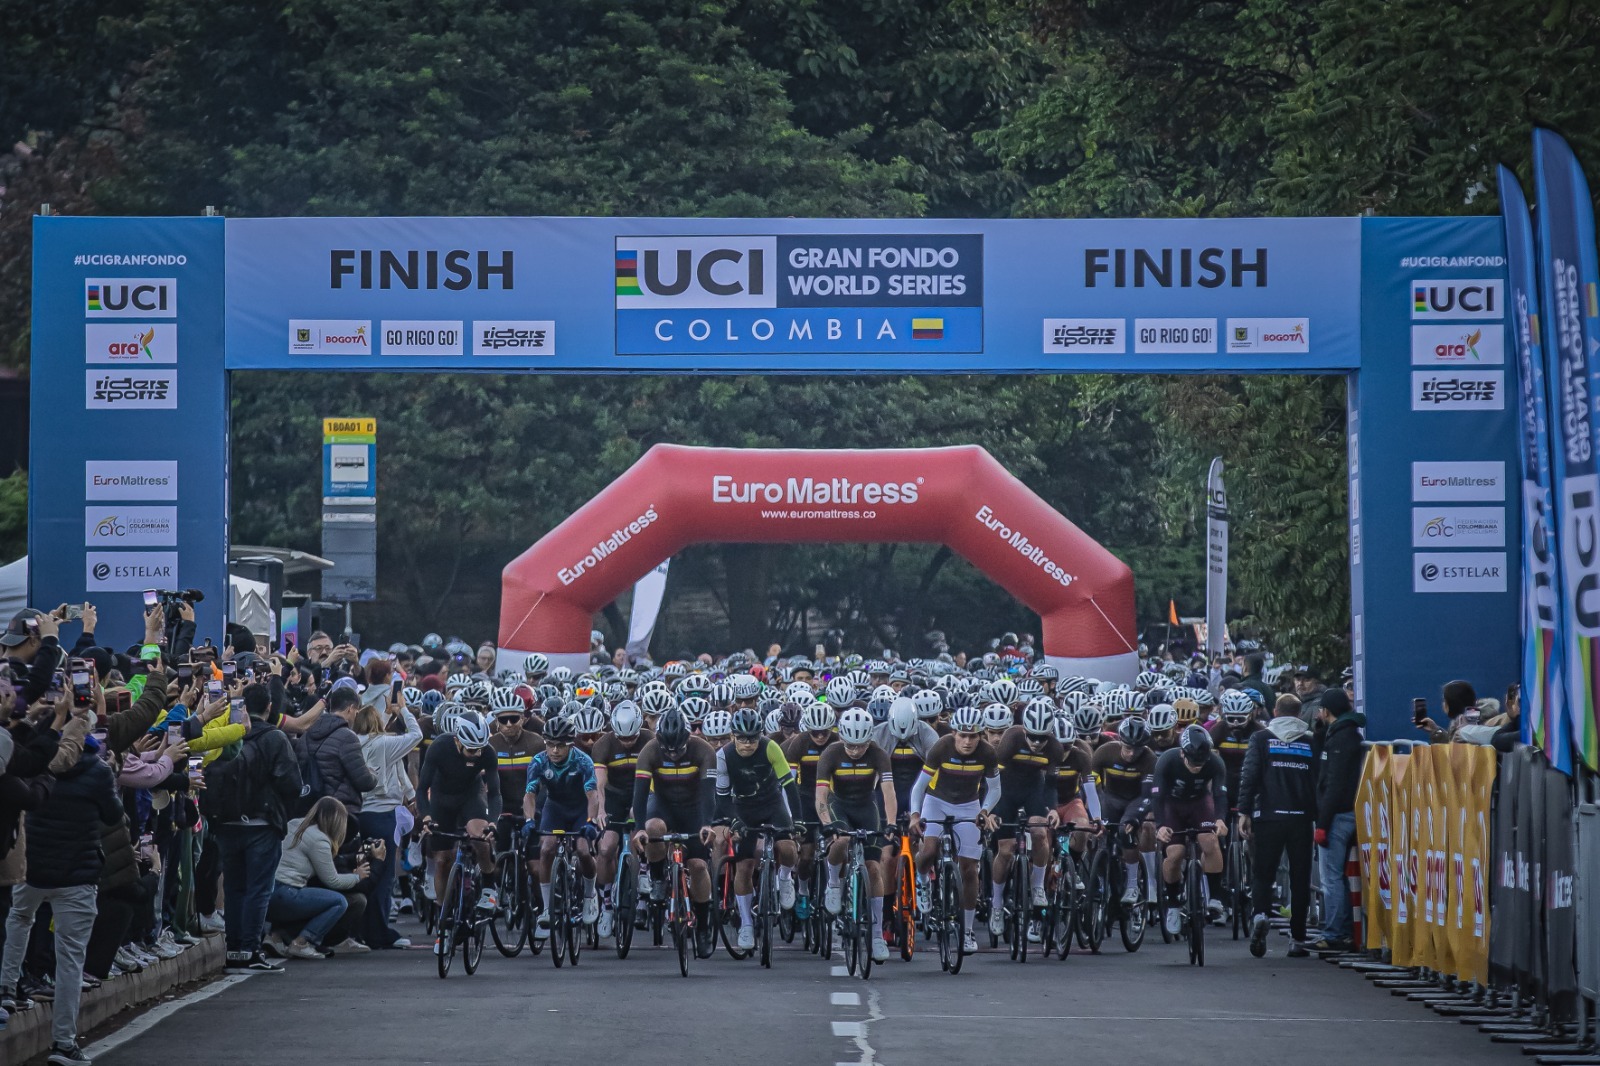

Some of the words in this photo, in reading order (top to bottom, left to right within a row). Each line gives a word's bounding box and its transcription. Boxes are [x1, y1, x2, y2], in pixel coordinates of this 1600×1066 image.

[74, 254, 187, 266] #UCIGRANFONDO
[789, 247, 862, 269] GRAN
[869, 247, 959, 269] FONDO
[1401, 256, 1507, 267] #UCIGRANFOND
[330, 249, 513, 291] FINISH
[643, 248, 764, 296] UCI
[1084, 247, 1268, 289] FINISH
[788, 275, 880, 296] WORLD
[887, 275, 967, 296] SERIES
[102, 285, 167, 311] UCI
[1430, 286, 1494, 312] UCI
[654, 318, 897, 342] COLOMBIA
[1140, 327, 1156, 344] GO
[1160, 327, 1188, 344] RIGO
[1192, 327, 1212, 344] GO!
[386, 330, 402, 346] GO
[406, 330, 434, 346] RIGO
[438, 330, 458, 346] GO!
[108, 342, 139, 355] ara
[1435, 344, 1466, 357] ara
[96, 375, 170, 390] riders
[1422, 377, 1497, 390] riders
[93, 390, 168, 402] sports
[1420, 391, 1494, 404] sports
[761, 509, 877, 519] www.euromattress.co
[115, 566, 171, 577] ESTELAR
[1443, 566, 1500, 578] ESTELAR
